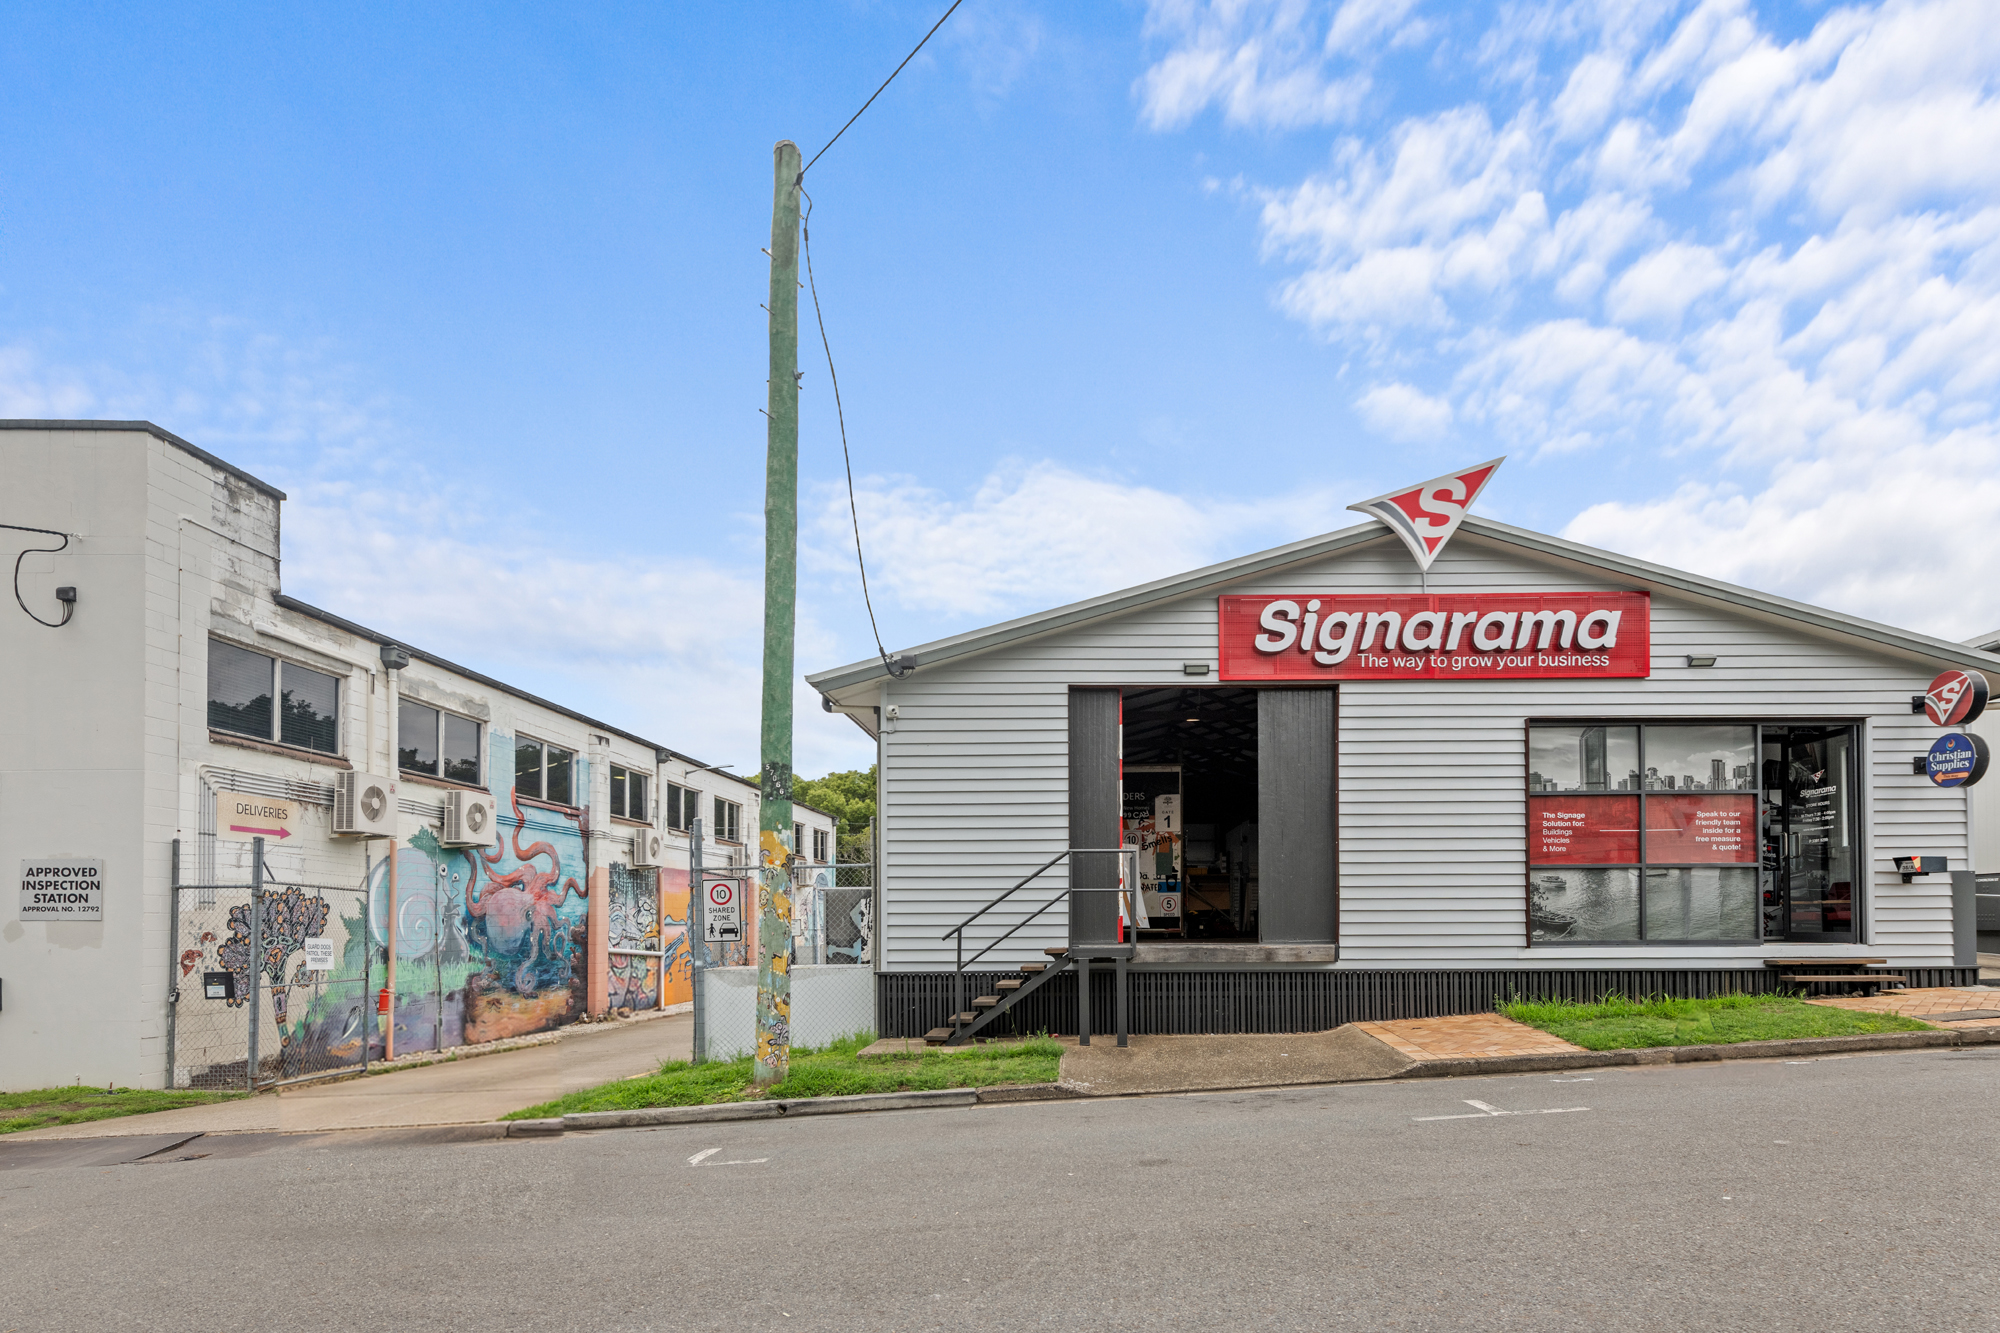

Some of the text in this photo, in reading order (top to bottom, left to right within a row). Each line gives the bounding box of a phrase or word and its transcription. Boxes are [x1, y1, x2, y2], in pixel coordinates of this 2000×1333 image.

[1254, 599, 1622, 665] Signarama
[1357, 652, 1610, 671] The way to grow your business
[1929, 750, 1972, 763] Christian
[1930, 759, 1970, 772] Supplies
[1123, 792, 1145, 800] DERS
[1800, 785, 1836, 798] Signarama
[236, 802, 288, 820] DELIVERIES
[1164, 815, 1170, 828] 1
[1127, 836, 1136, 844] 10
[1141, 835, 1172, 850] Smells
[25, 867, 97, 877] APPROVED
[22, 880, 100, 891] INSPECTION
[33, 893, 89, 904] STATION
[716, 889, 726, 899] 10
[1166, 900, 1172, 909] 5
